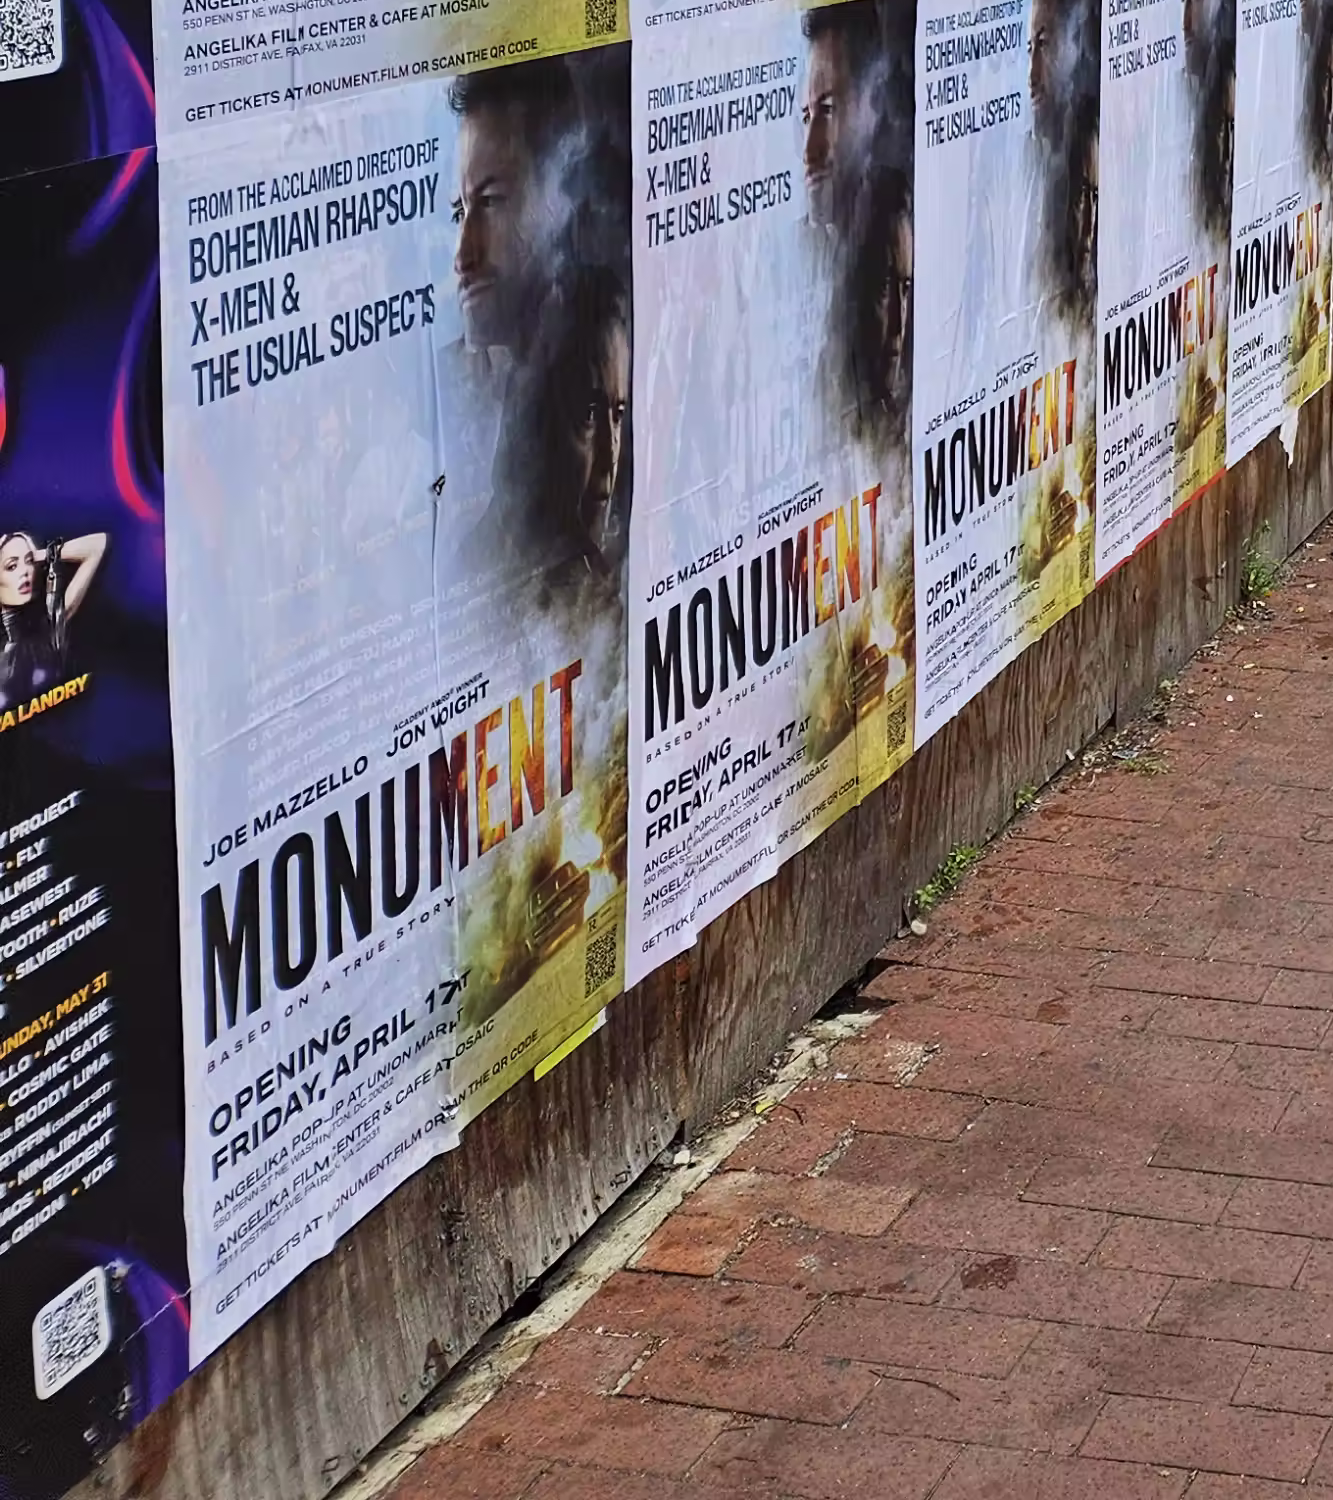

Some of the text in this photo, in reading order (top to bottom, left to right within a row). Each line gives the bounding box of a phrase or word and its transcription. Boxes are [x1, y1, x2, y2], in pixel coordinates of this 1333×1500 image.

[184, 34, 268, 61] ANGELIKA
[308, 17, 366, 38] CENTER
[368, 13, 379, 28] &
[382, 8, 419, 26] CAFE
[421, 4, 437, 19] AT
[204, 12, 234, 26] PENN
[212, 35, 367, 72] DISTRICT 22031
[645, 6, 702, 27] GET TICKETS
[186, 38, 538, 122] GET TICKETS OR SCAN THE QR CODE
[648, 102, 724, 155] BOHEMIAN
[188, 160, 353, 226] FROM THE ACCLAIMED
[646, 151, 711, 202] X-MEN &
[189, 204, 320, 284] BOHEMIAN
[678, 194, 724, 238] USUAL
[190, 272, 301, 347] X-MEN &
[1103, 263, 1218, 415] MONUMENT
[191, 349, 240, 407] THE
[246, 322, 325, 387] USUAL
[924, 357, 1077, 547] MONUMENT
[645, 482, 882, 742] MONUMENT
[18, 674, 89, 723] LANDRY
[386, 680, 490, 758] JON VOIGHT
[717, 721, 796, 793] APRIL 17
[10, 790, 80, 843] PROJECT
[203, 754, 369, 868] JOE MAZZELLO
[17, 837, 48, 868] FLY
[200, 658, 582, 1048] MONUMENT
[59, 885, 104, 926] RUZE
[15, 907, 111, 981] SILVERTONE
[44, 997, 111, 1056] AVISHEK
[55, 971, 110, 1020] MAY 31
[7, 1023, 112, 1108] COSMIC GATE
[14, 1052, 113, 1133] RODDY LIMA
[209, 1015, 352, 1138] OPENING
[211, 1008, 416, 1182] FRIDAY, APRIL
[17, 1102, 112, 1186] NINAJIRACHI
[42, 1127, 113, 1195] REZIDENT
[11, 1154, 117, 1245] ORION YDG
